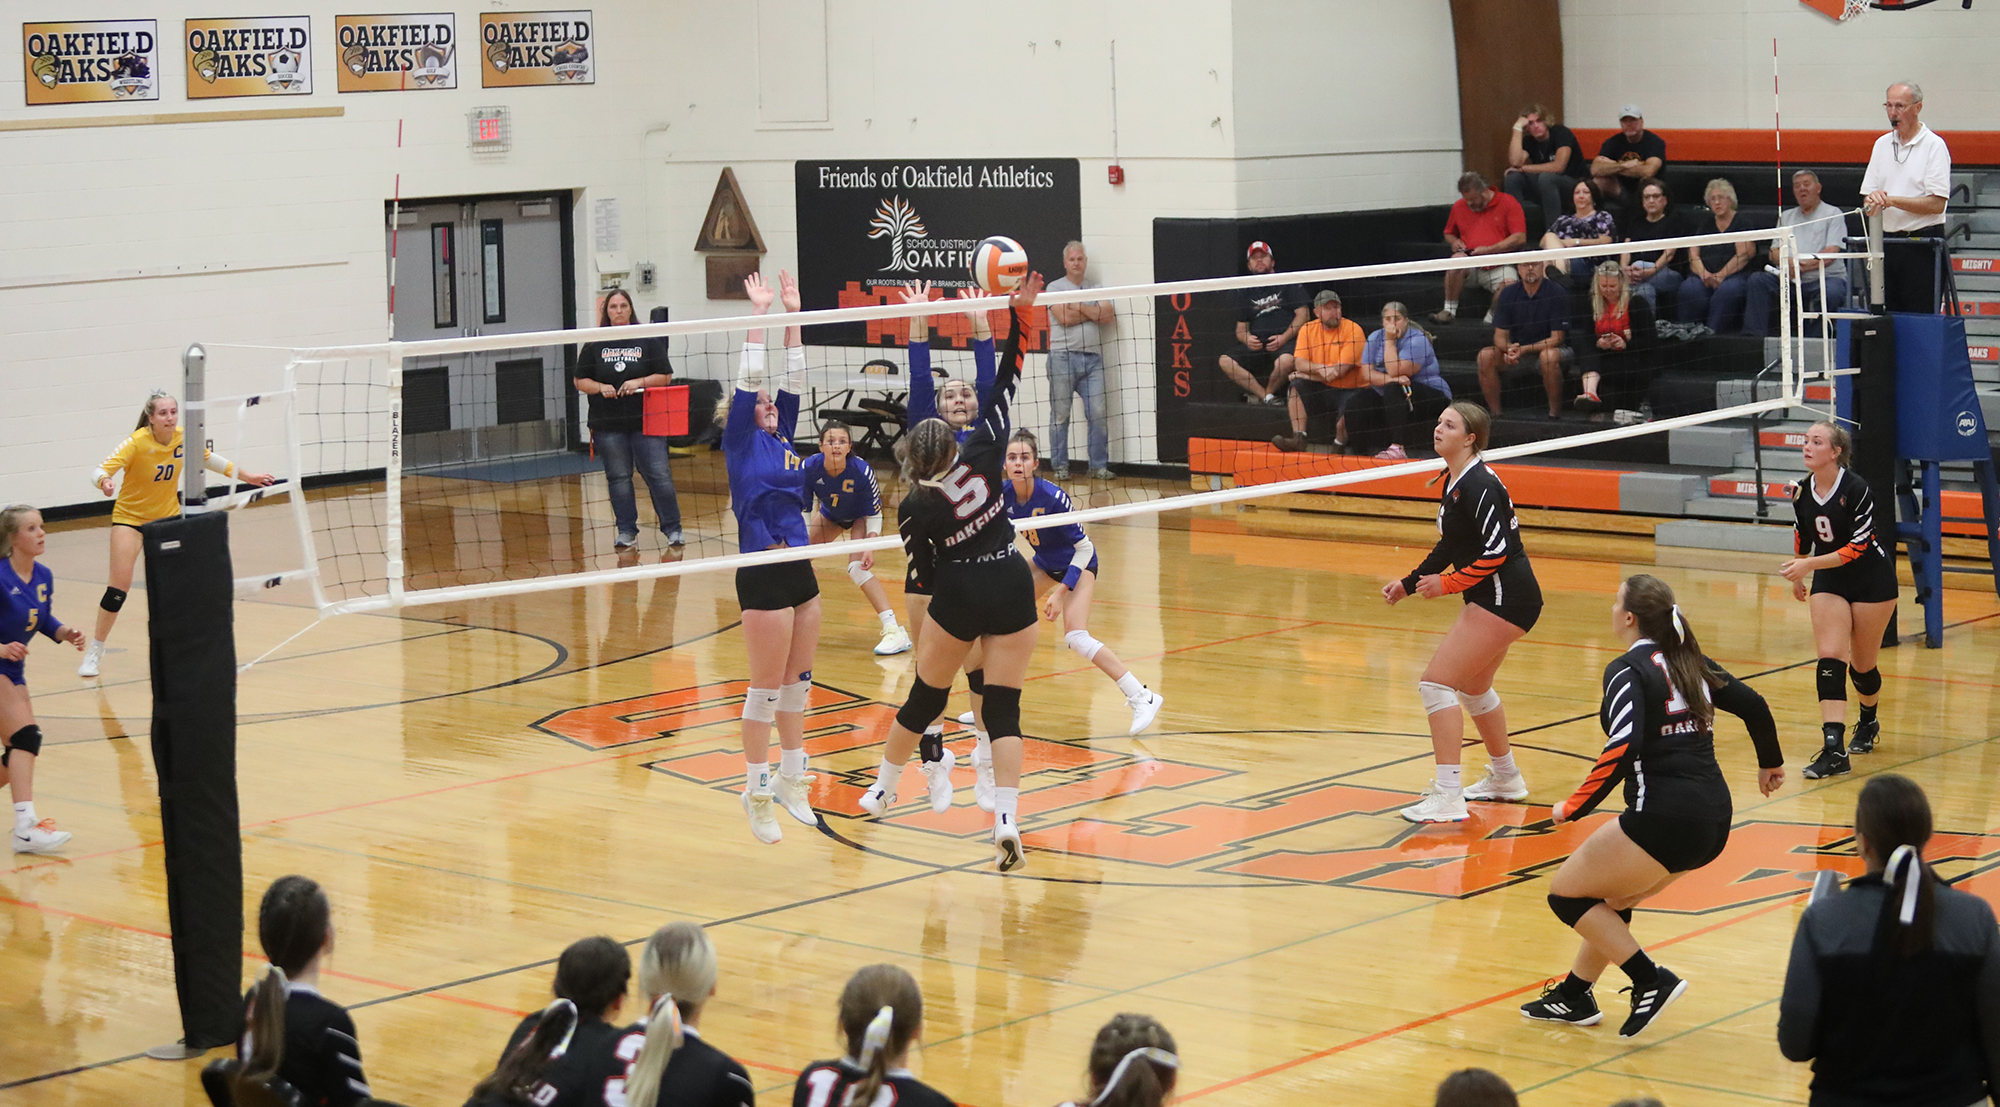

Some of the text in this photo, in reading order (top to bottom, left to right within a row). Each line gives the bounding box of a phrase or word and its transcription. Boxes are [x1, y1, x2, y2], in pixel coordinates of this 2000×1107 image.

[190, 28, 307, 52] OAKFIELD
[340, 24, 451, 47] OAKFIELD
[484, 21, 589, 44] OAKFIELD
[28, 31, 153, 58] OAKFIELD
[479, 118, 499, 140] EXIT
[818, 165, 1054, 188] Friends of Oakfield Athletics
[906, 239, 939, 249] SCHOOL
[940, 239, 977, 249] DISTRICT
[906, 250, 972, 268] OAKFIE
[1961, 259, 1993, 270] MIGHTY
[1171, 293, 1192, 397] OAKS
[391, 411, 400, 458] BLAZER
[1784, 434, 1806, 446] MIGH
[154, 464, 175, 482] 20
[842, 479, 855, 493] C
[937, 462, 990, 520] 5
[1735, 482, 1770, 495] MIGHY
[945, 493, 1005, 547] OAKFIELD
[1814, 515, 1834, 543] 9
[37, 583, 48, 603] C
[25, 608, 39, 632] 5
